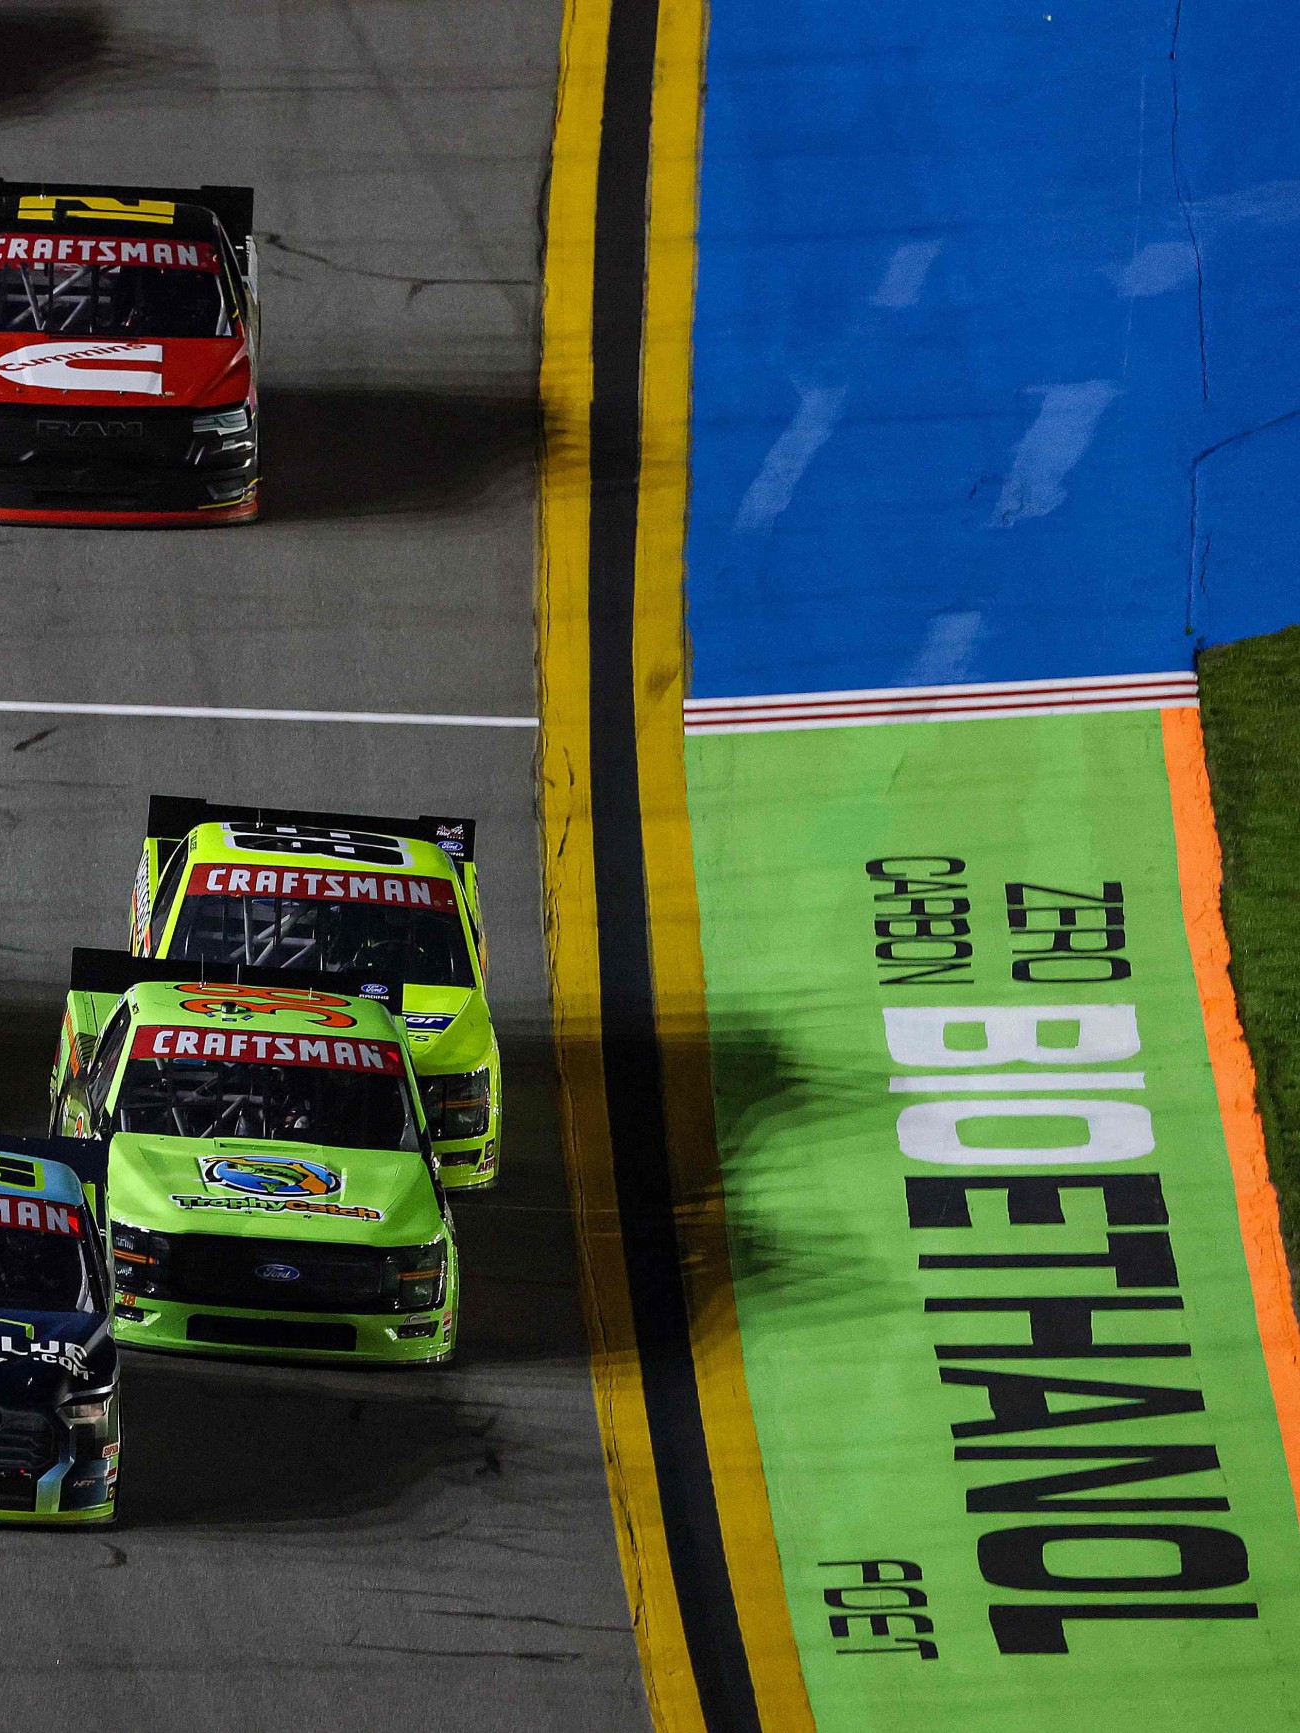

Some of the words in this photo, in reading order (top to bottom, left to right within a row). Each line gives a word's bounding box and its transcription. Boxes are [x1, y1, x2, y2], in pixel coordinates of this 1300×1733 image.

[36, 419, 143, 437] RAM
[206, 868, 431, 906] CRAFTSMAN
[865, 856, 975, 985] CARBON
[1004, 880, 1132, 983] ZERO
[152, 1030, 384, 1069] CRAFTSMAN
[173, 1194, 381, 1220] TrophyCatch
